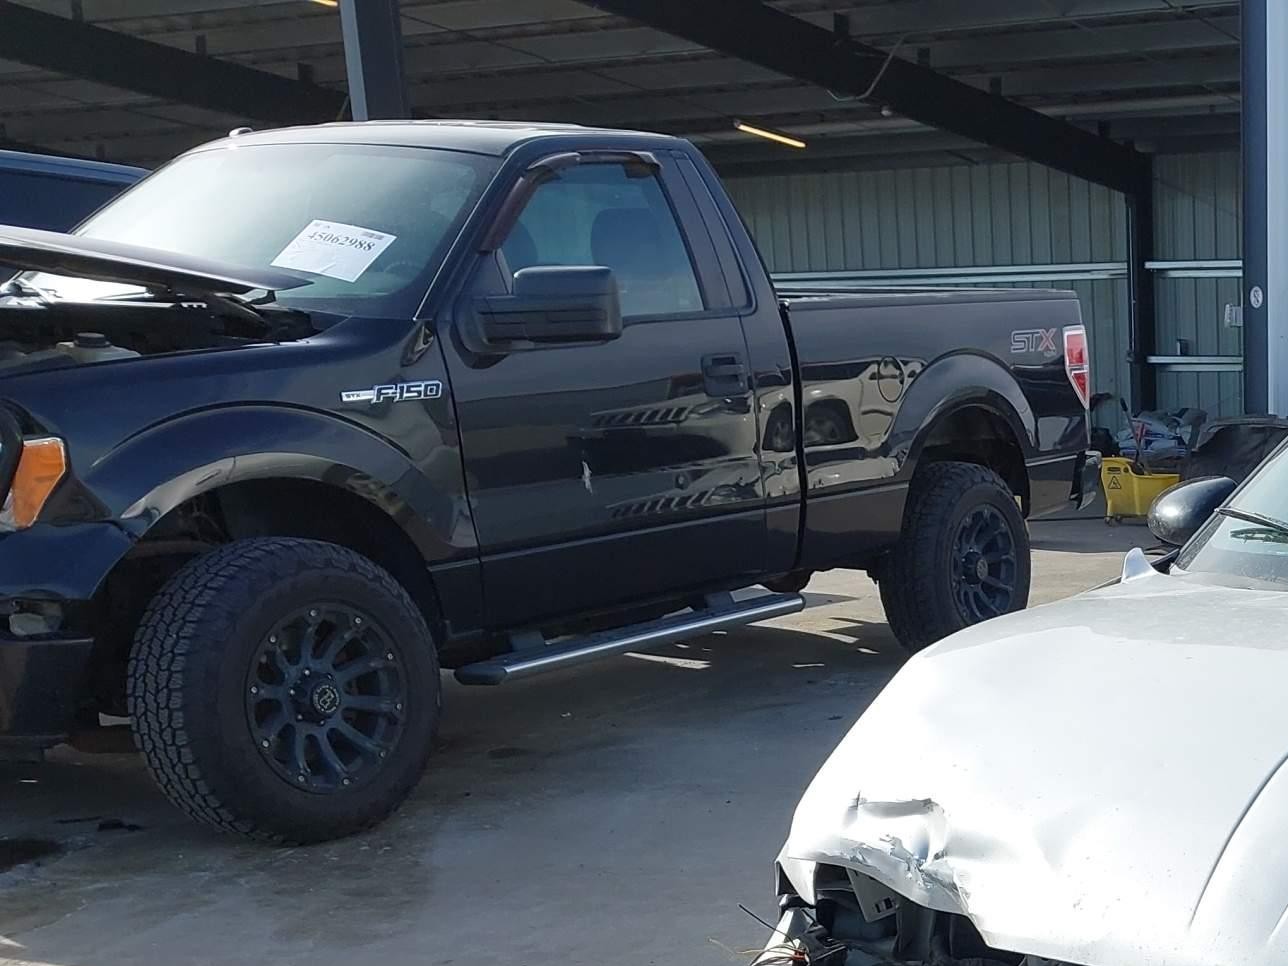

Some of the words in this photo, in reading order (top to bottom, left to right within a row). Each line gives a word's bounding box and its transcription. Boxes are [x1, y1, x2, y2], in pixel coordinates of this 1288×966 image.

[308, 231, 375, 251] 45062988
[1010, 328, 1057, 353] STX
[371, 380, 442, 404] F-150
